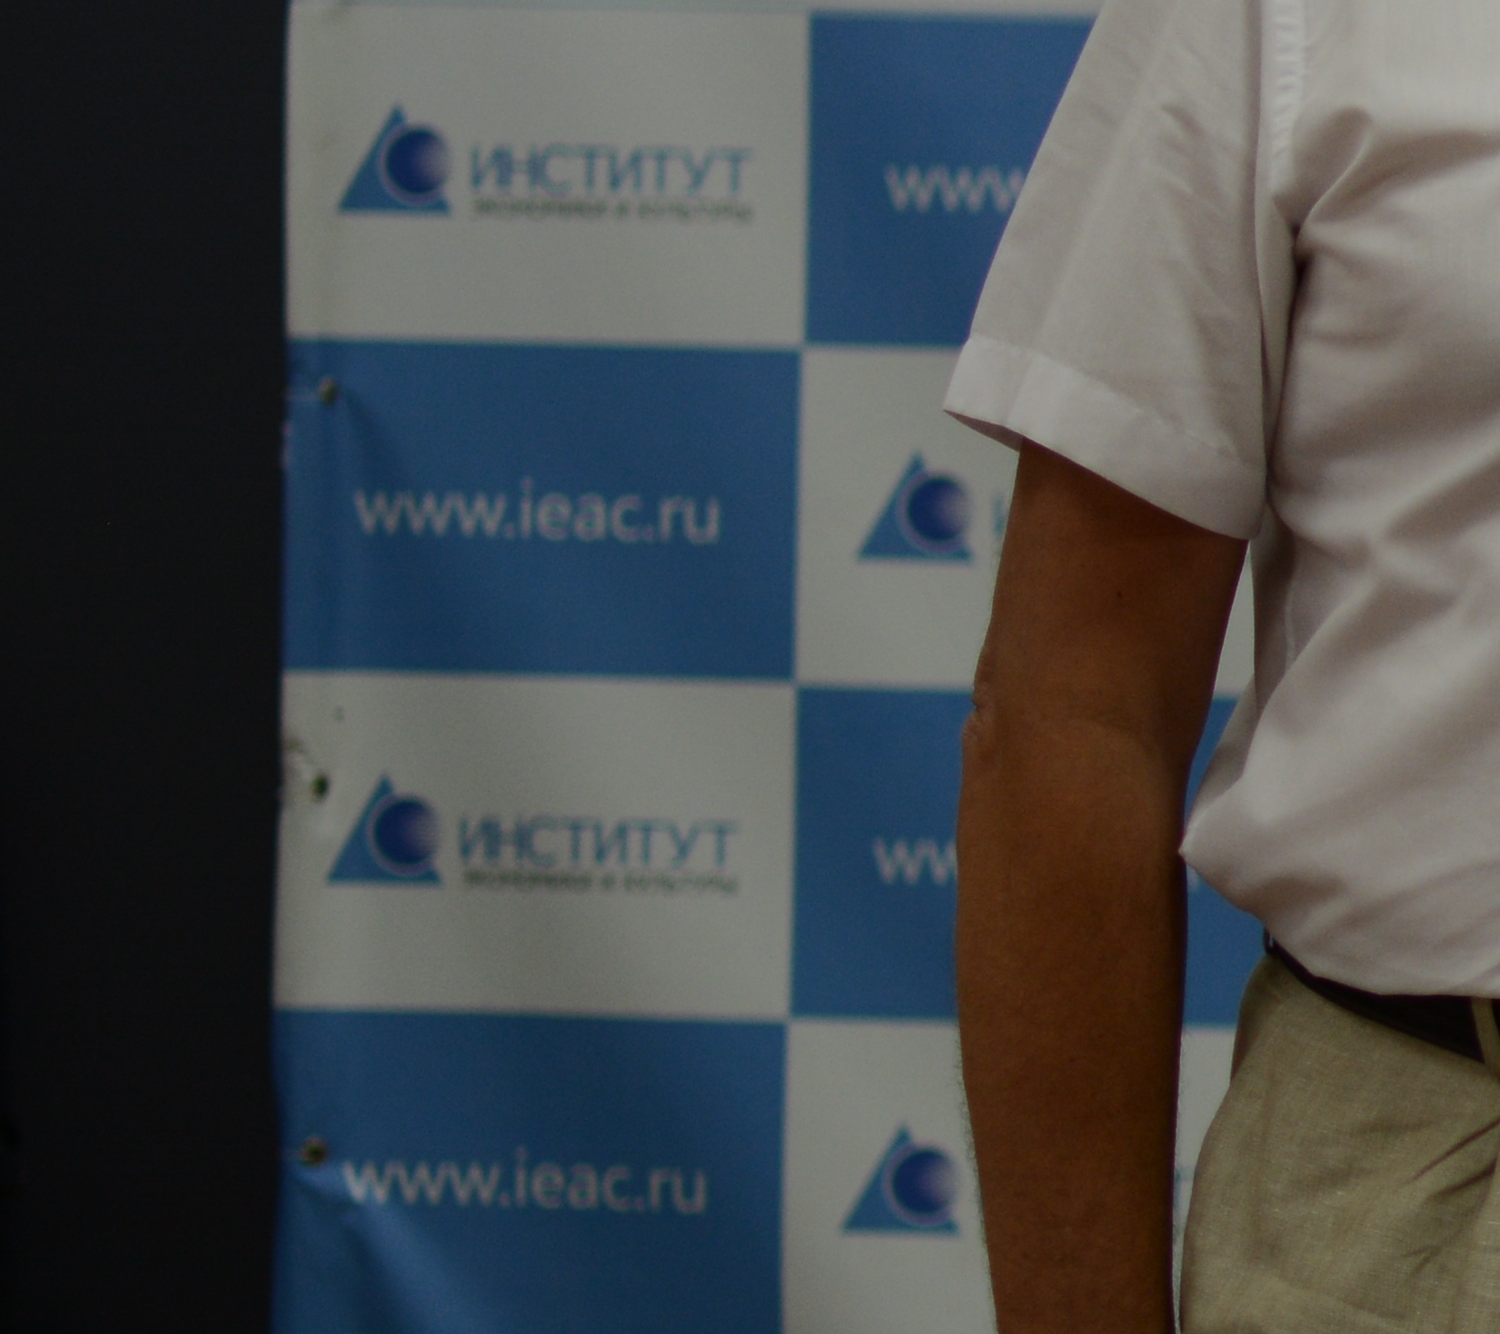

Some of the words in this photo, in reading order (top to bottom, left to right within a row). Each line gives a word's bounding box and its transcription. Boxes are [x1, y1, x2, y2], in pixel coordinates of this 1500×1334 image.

[470, 143, 754, 196] ИНСТИТУТ
[354, 478, 721, 544] www.ieac.ru
[458, 819, 739, 869] ИНСТИТУТ
[348, 1147, 708, 1216] www.ieac.ru
